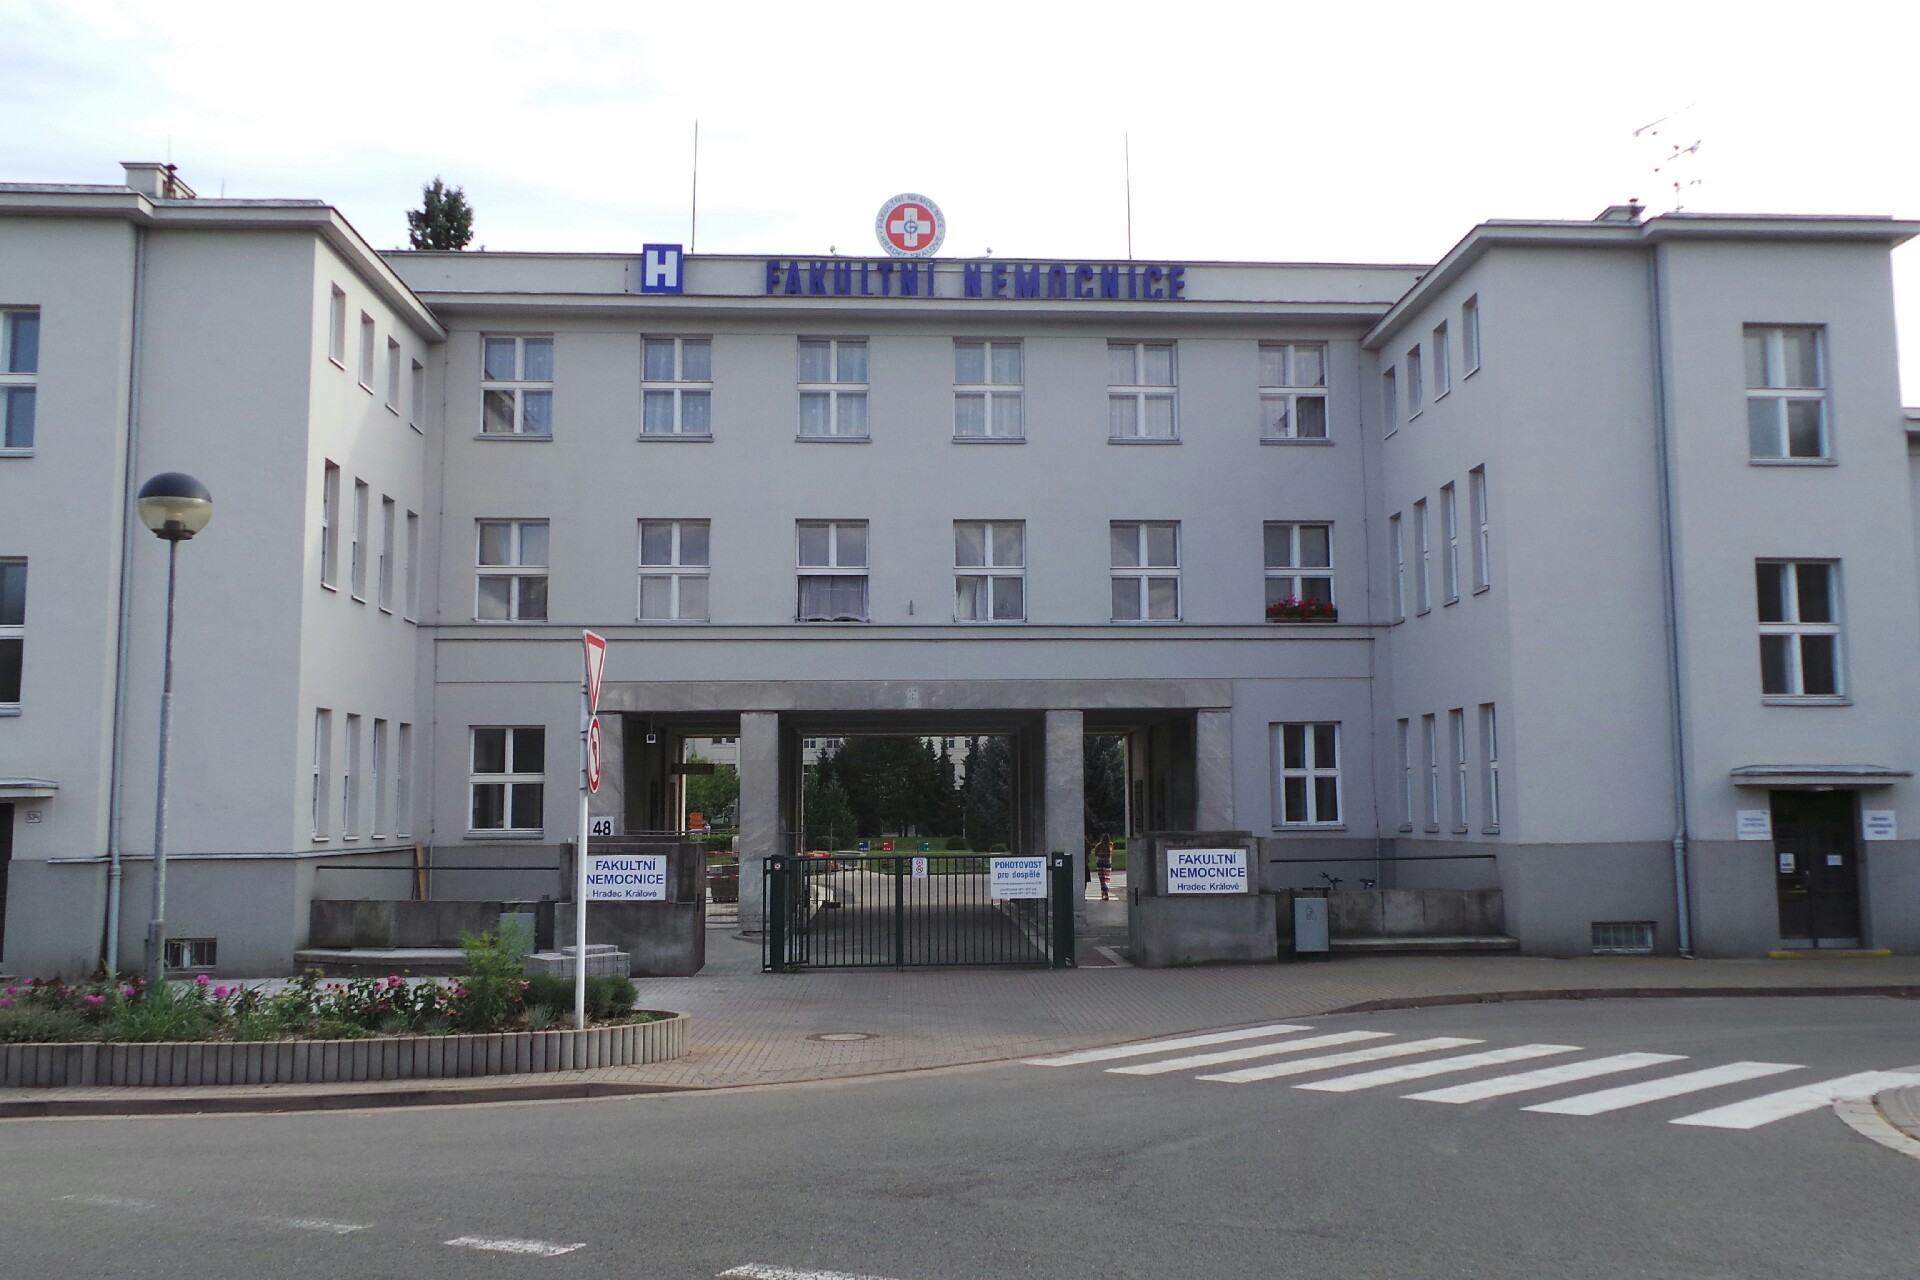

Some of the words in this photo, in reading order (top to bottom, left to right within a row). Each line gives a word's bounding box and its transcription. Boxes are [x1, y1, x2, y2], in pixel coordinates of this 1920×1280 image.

[645, 250, 678, 287] H
[964, 263, 1186, 299] NEMOCNICE
[593, 820, 611, 836] 48
[1178, 851, 1237, 865] FAKULTNÍ
[595, 858, 656, 871] FAKULTNÍ
[994, 861, 1043, 869] POHOTOVOST
[997, 872, 1009, 880] pro
[1012, 870, 1041, 879] dospělé
[1170, 867, 1246, 878] NEMOCNICE
[586, 874, 664, 885] NEMOCNICE
[1177, 883, 1206, 891] Hradec
[1209, 882, 1240, 891] Králové
[592, 890, 622, 898] Hradec
[625, 889, 657, 898] Králové
